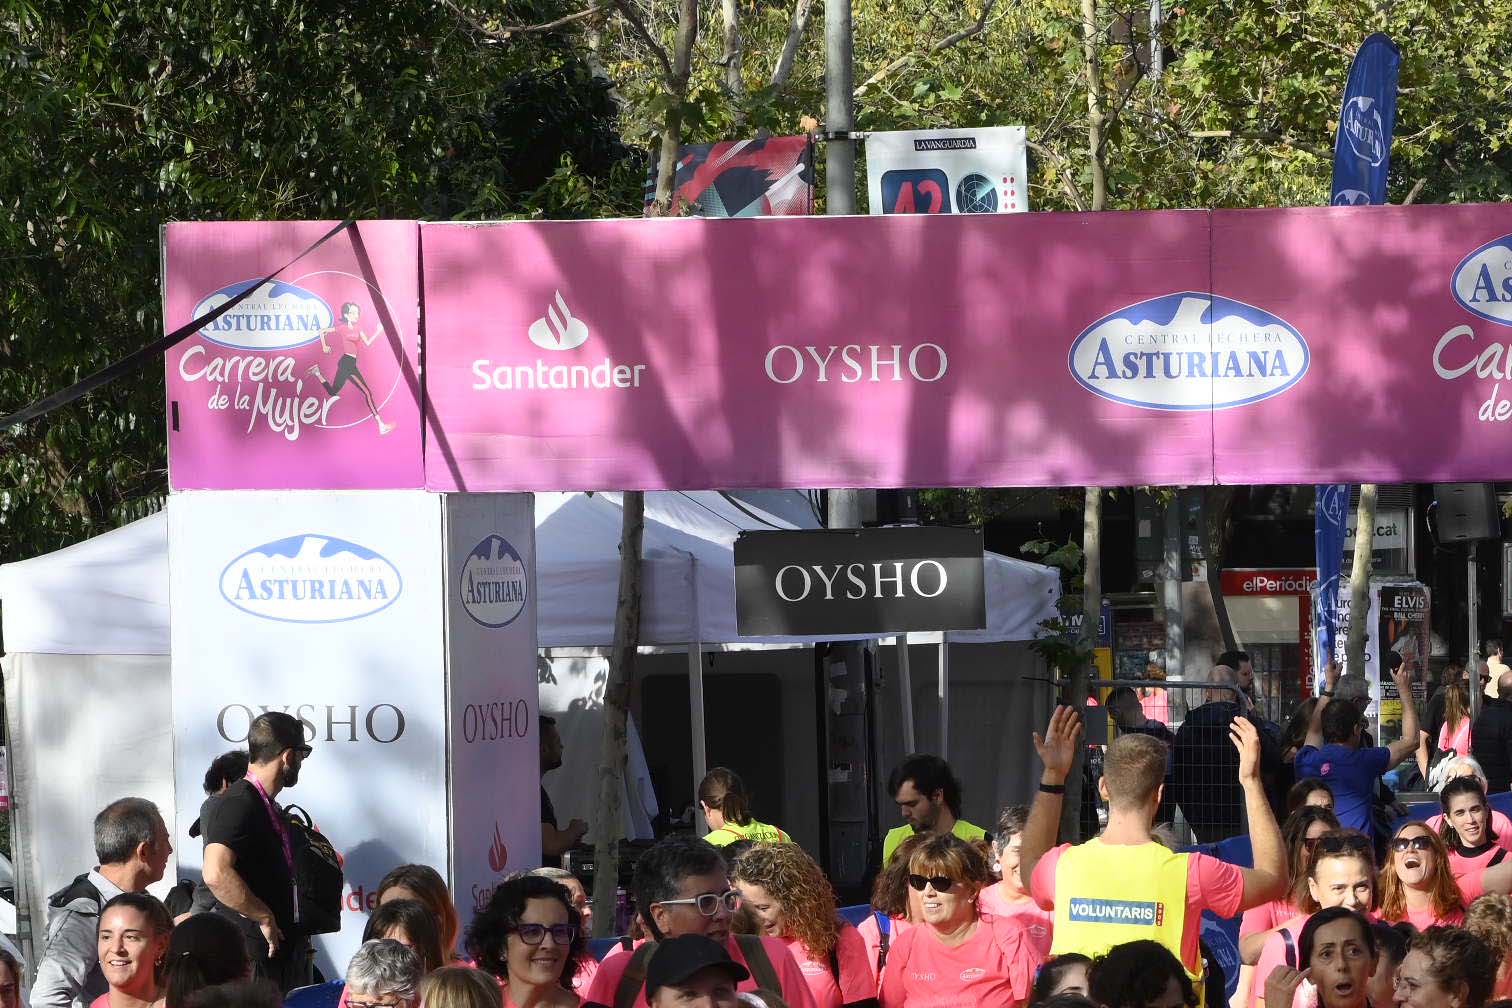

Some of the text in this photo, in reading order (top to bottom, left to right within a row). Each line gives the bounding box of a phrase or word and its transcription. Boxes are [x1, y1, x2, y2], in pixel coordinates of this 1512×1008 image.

[203, 304, 321, 332] ASTURIANA
[231, 303, 268, 311] ENTRAL
[1125, 331, 1282, 346] CENTRAL LECHERA
[179, 344, 296, 383] Carrera
[472, 357, 645, 391] Santander
[765, 343, 949, 385] OYSHO
[1087, 336, 1291, 380] ASTURIANA
[207, 377, 341, 441] de la Mujer
[1478, 383, 1512, 422] de
[234, 567, 388, 601] ASTURIANA
[465, 568, 525, 605] ASTURIANA
[774, 559, 949, 602] OYSHO
[1394, 595, 1425, 608] ELVIS
[463, 698, 530, 745] OYSHO
[1070, 903, 1154, 920] VOLUNTARIS
